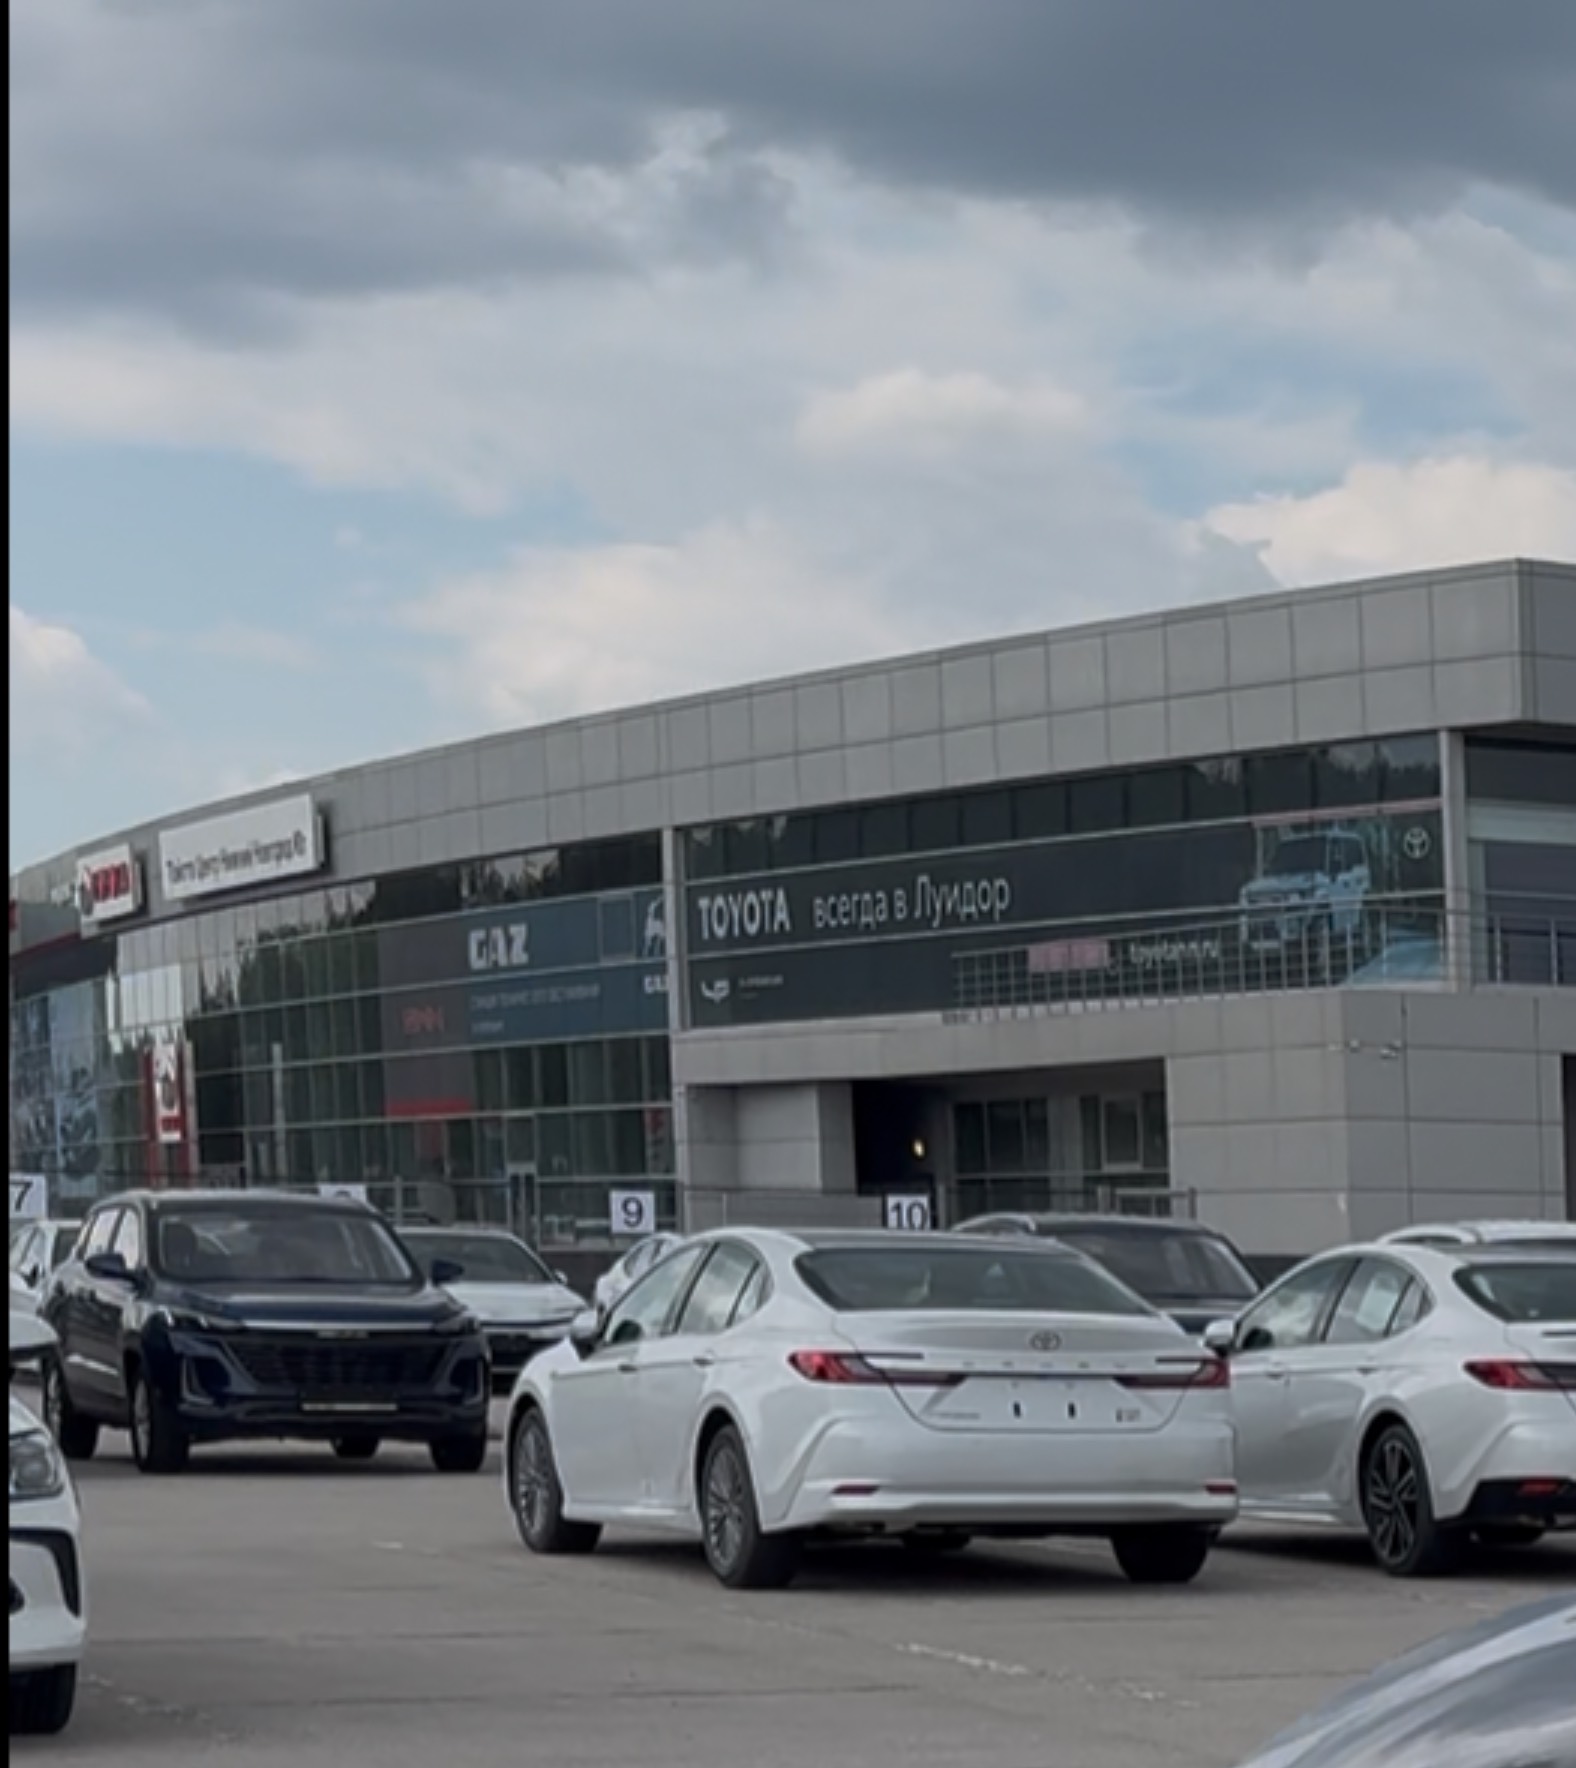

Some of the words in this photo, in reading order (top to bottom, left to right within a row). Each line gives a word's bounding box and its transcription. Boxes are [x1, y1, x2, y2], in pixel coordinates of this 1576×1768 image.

[698, 887, 791, 941] TOYOTA
[813, 889, 887, 931] всегда
[894, 888, 907, 920] в
[914, 873, 1010, 928] Луидор
[468, 922, 528, 970] GAZ
[624, 1198, 644, 1226] 9
[890, 1201, 929, 1230] 10
